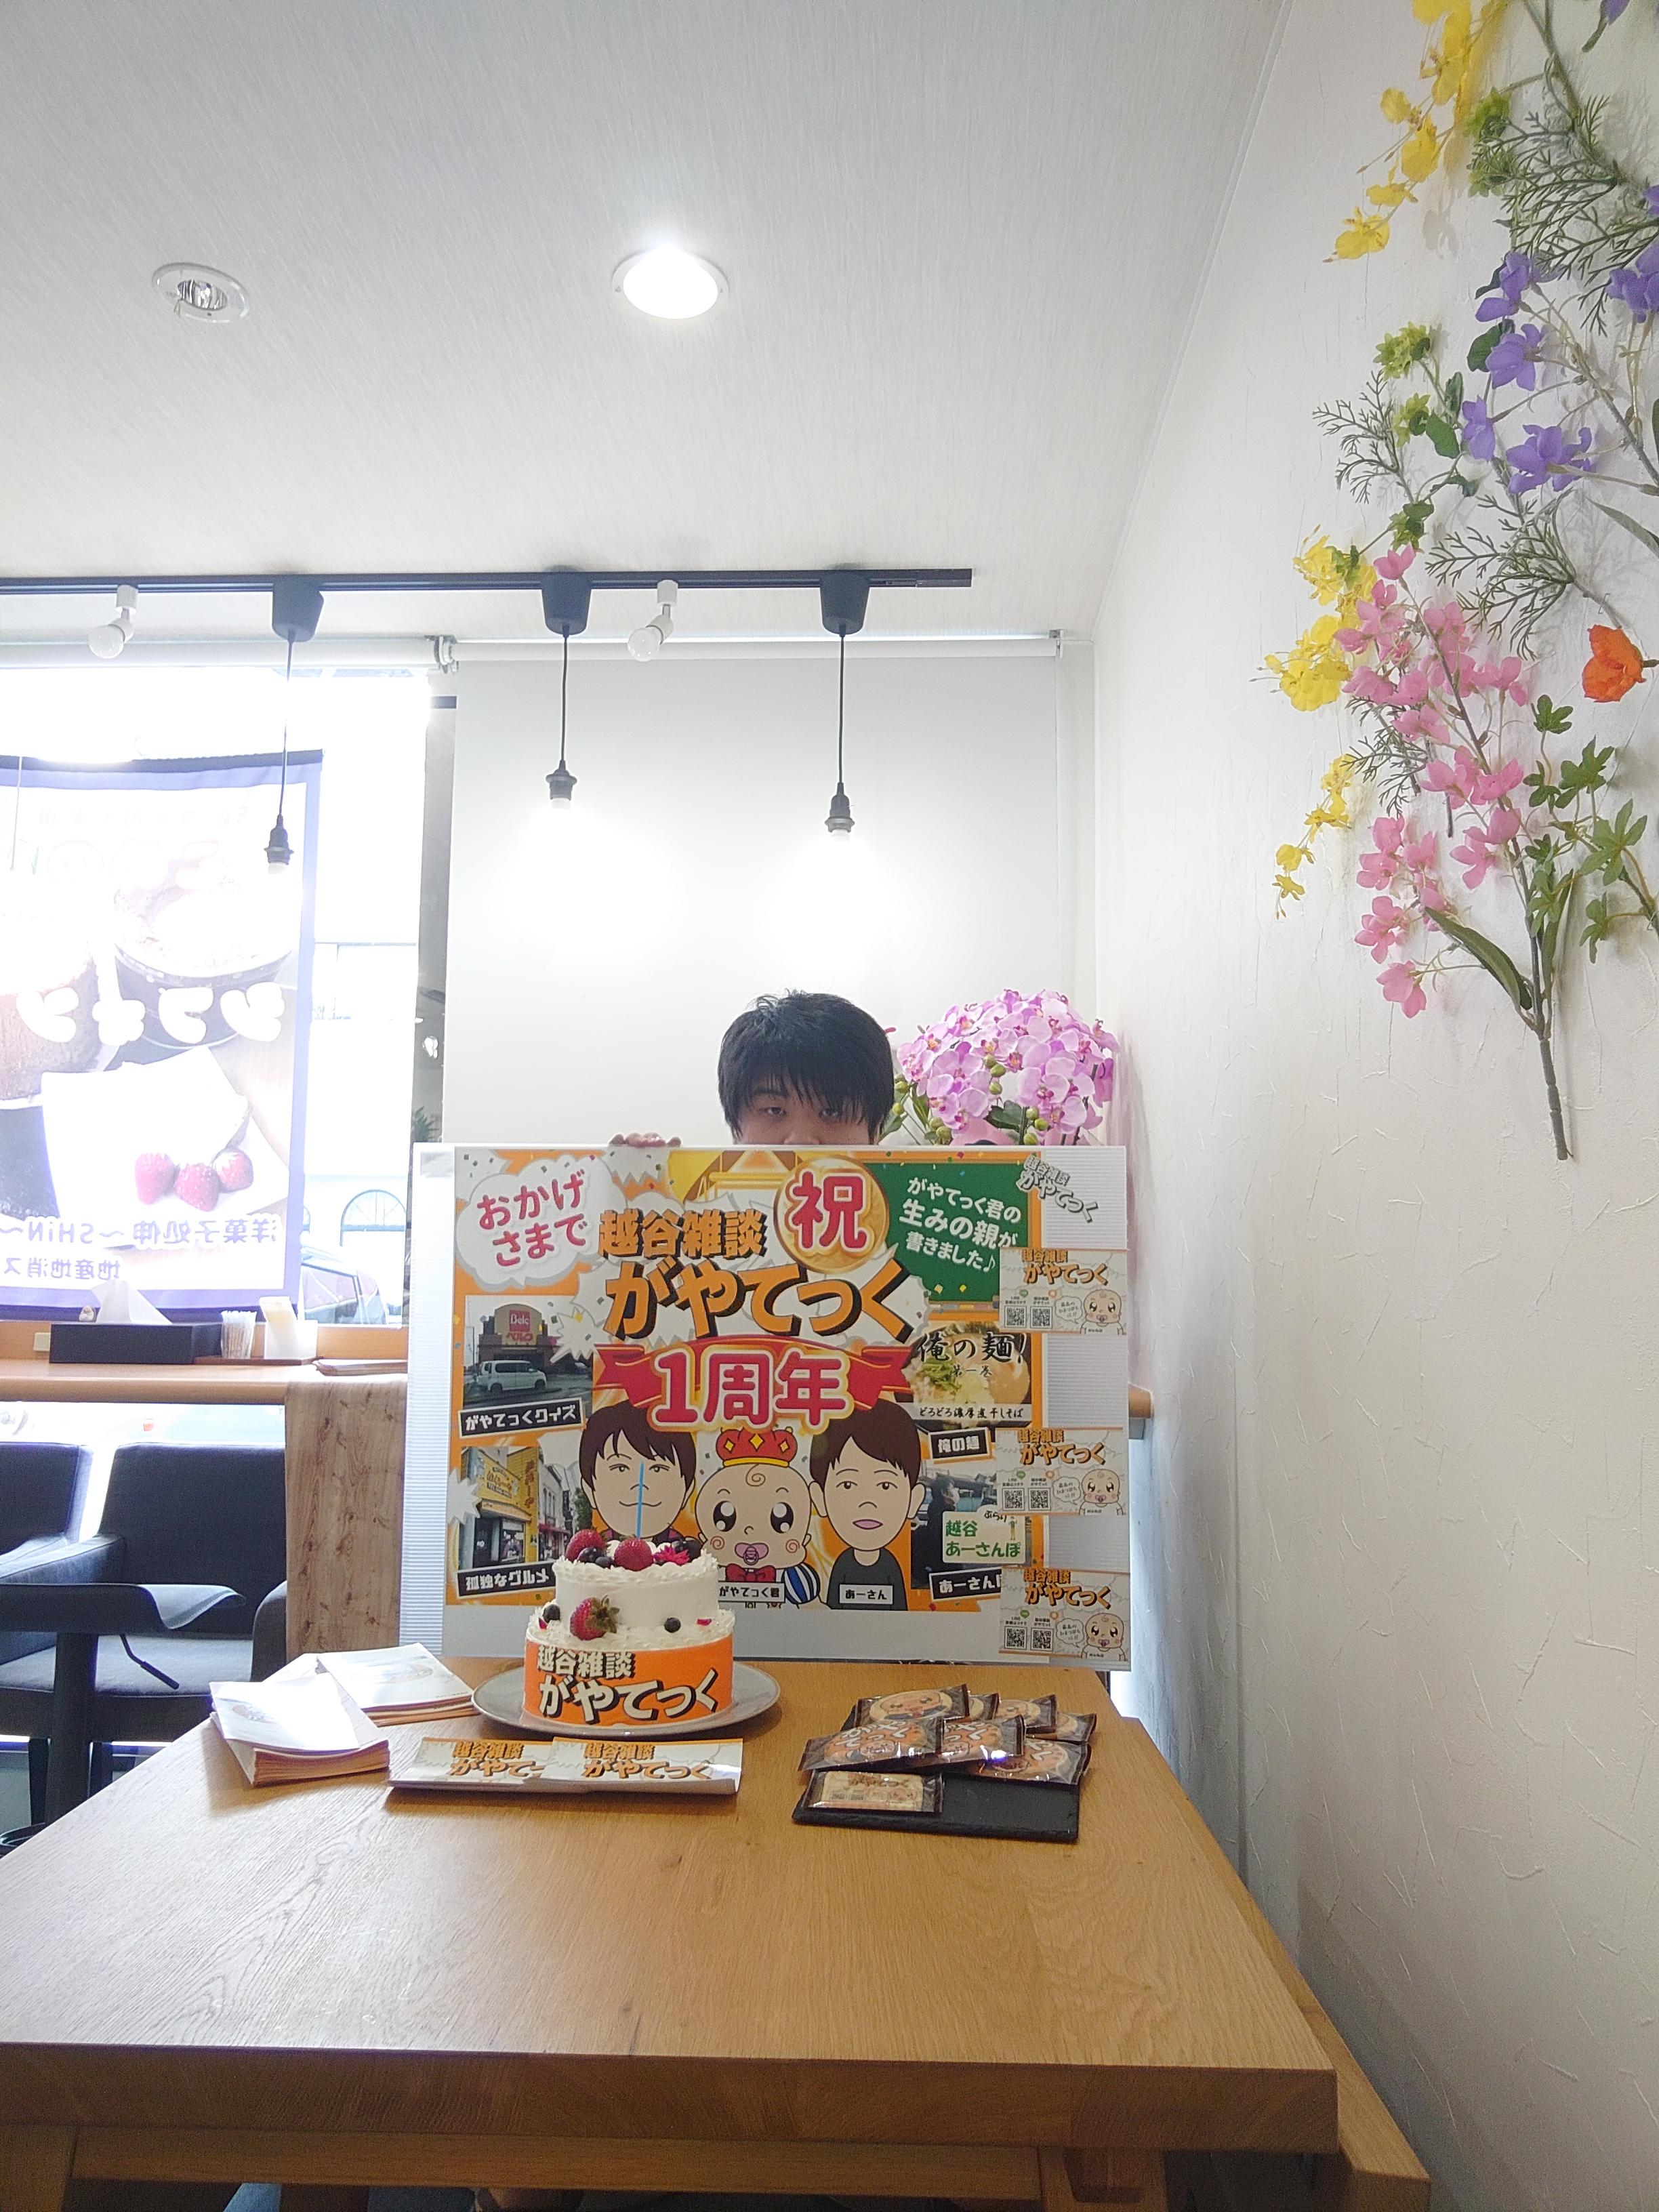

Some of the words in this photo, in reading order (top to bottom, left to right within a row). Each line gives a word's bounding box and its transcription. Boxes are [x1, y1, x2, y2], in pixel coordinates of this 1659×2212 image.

[477, 1169, 584, 1230] おかげ
[792, 1171, 868, 1251] 祝
[907, 1177, 1021, 1223] がやてっく君の
[493, 1214, 587, 1267] さまで
[598, 1208, 768, 1260] 越谷雑談
[899, 1198, 1018, 1250] 生みの親が
[905, 1231, 983, 1270] 書きました
[652, 1352, 847, 1426] 1周年
[938, 1435, 980, 1454] 俺の麺
[945, 1520, 978, 1537] 越谷
[945, 1541, 1021, 1557] あーさんぽ
[465, 1568, 550, 1591] 孤独なグルメ
[845, 1589, 887, 1600] あーさん
[537, 1644, 636, 1680] 越谷雑談
